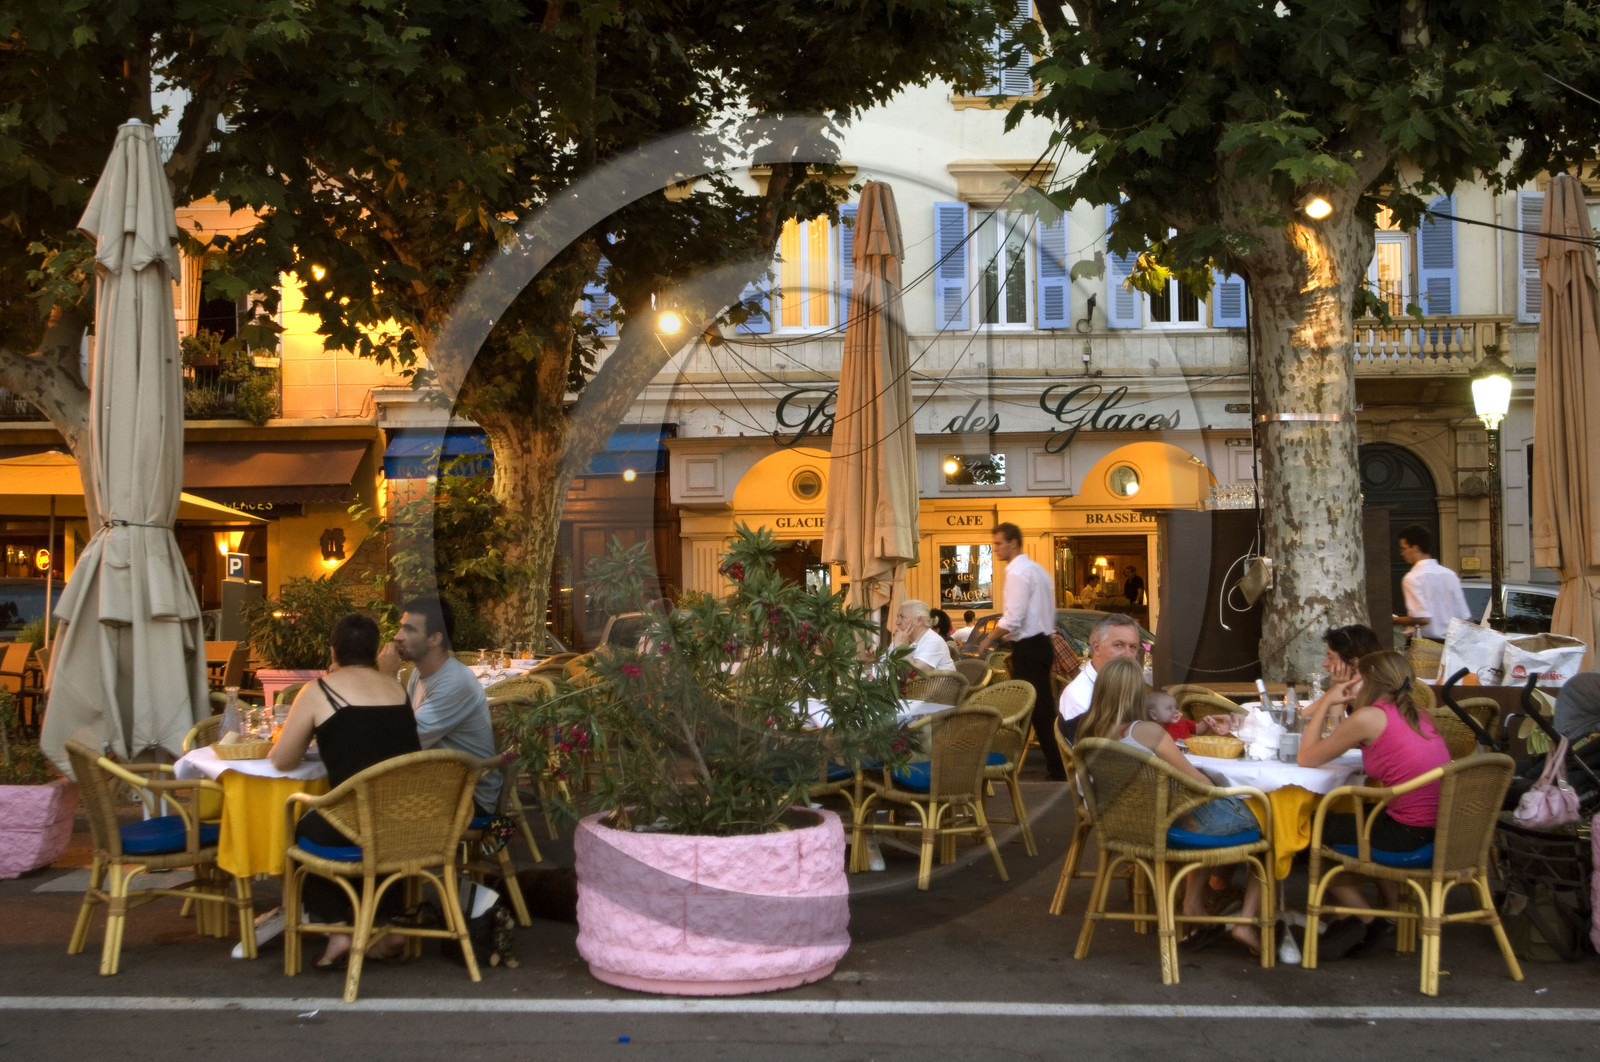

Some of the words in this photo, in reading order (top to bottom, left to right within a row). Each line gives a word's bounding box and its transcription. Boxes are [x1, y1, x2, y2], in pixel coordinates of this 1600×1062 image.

[941, 398, 1000, 434] des
[1039, 384, 1180, 454] Glaces
[946, 515, 984, 526] CAFE
[229, 557, 242, 575] P
[957, 572, 974, 581] des
